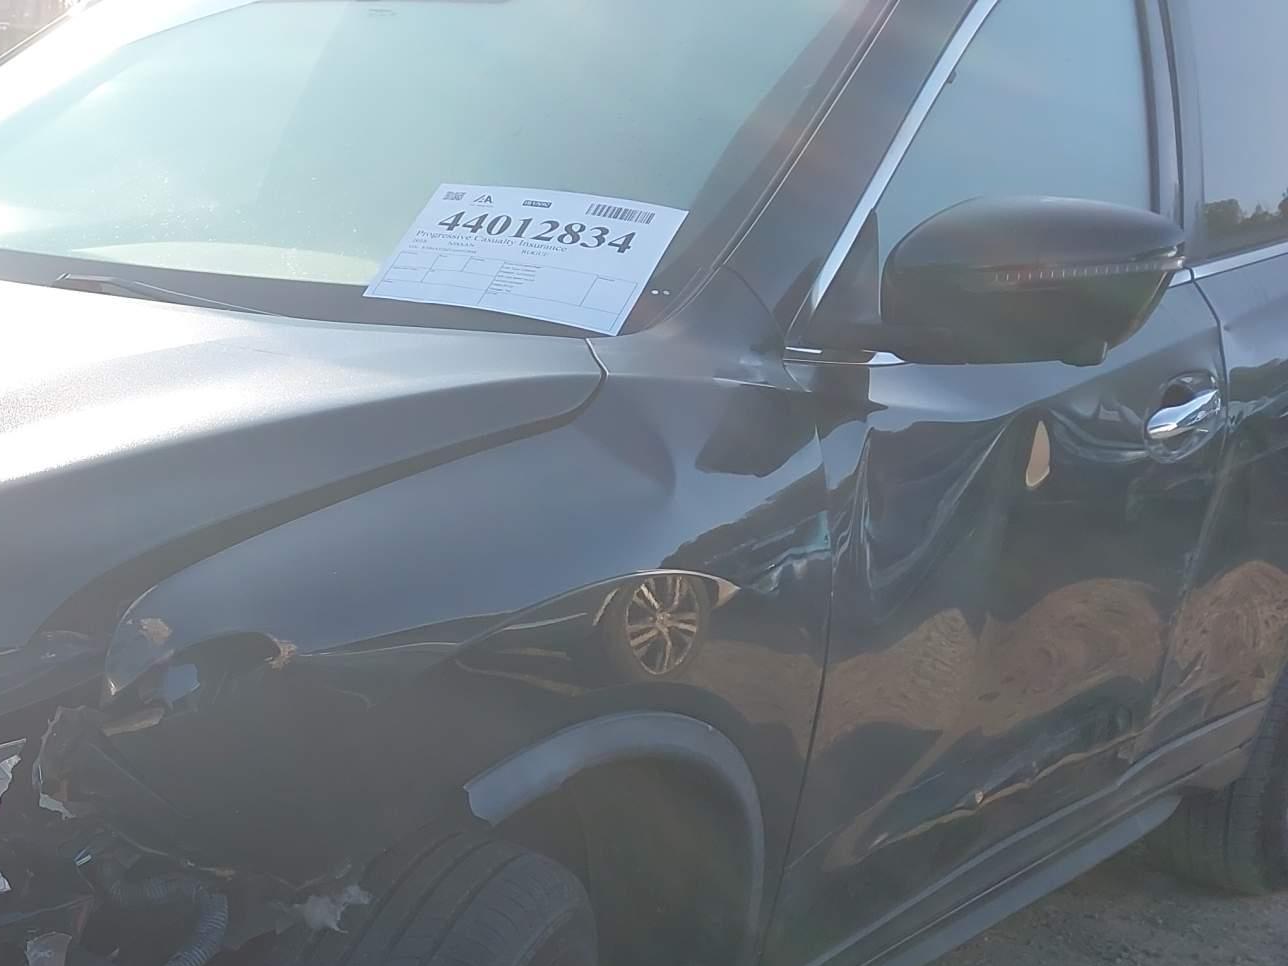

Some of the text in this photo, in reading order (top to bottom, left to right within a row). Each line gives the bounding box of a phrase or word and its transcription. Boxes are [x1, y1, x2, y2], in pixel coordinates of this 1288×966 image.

[416, 230, 568, 252] Progressive Casualty Insurance
[438, 210, 636, 254] 44012834
